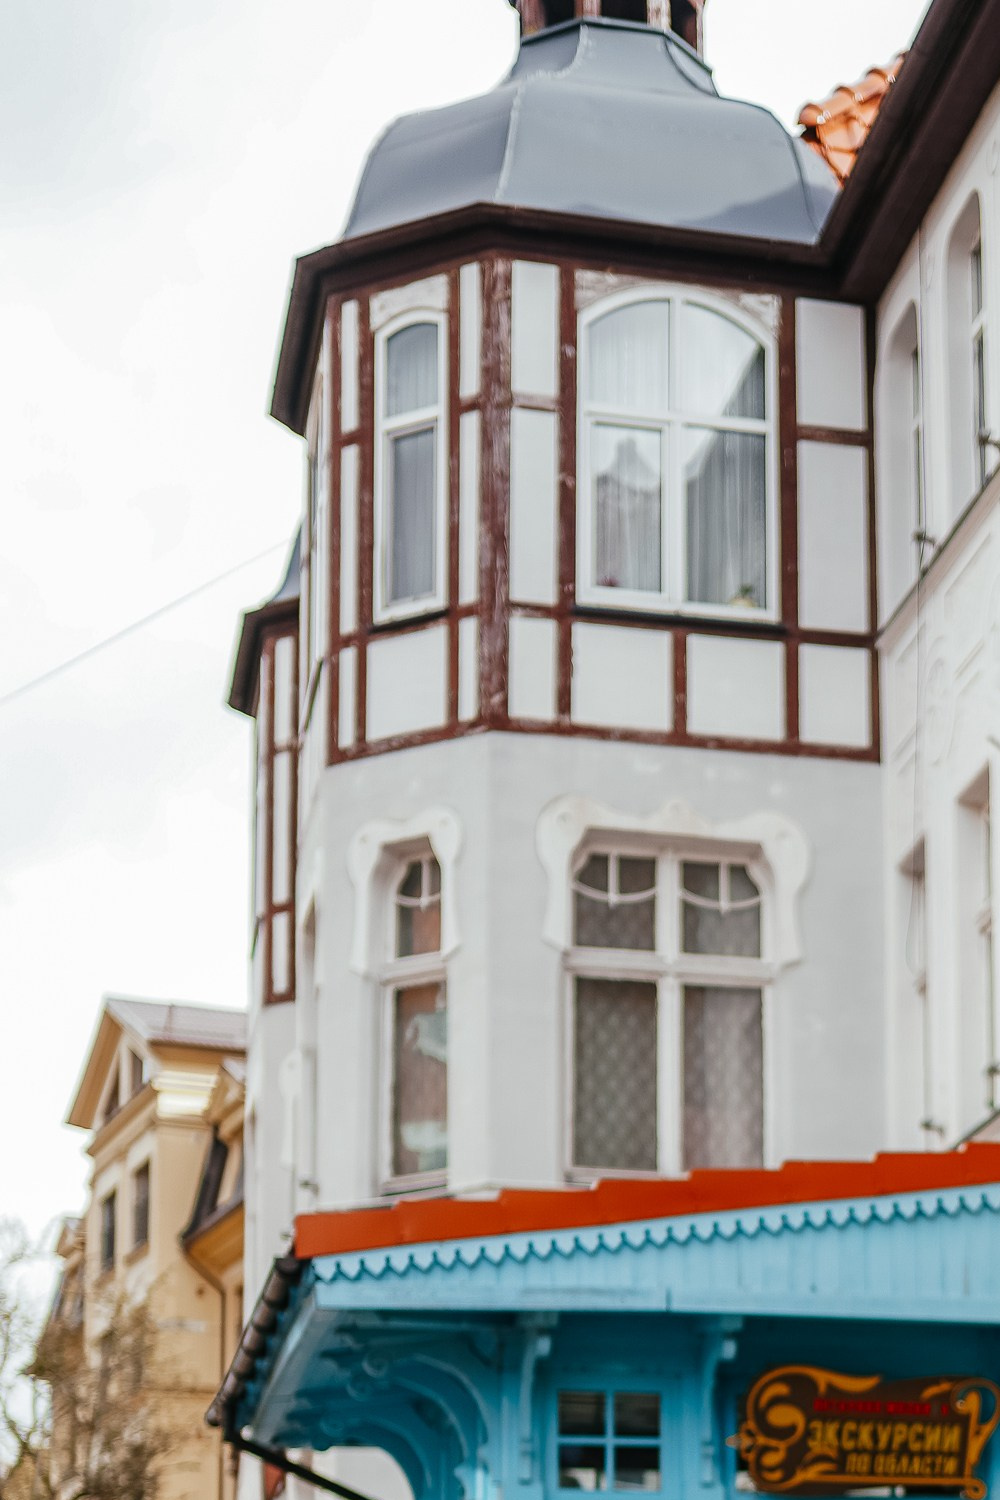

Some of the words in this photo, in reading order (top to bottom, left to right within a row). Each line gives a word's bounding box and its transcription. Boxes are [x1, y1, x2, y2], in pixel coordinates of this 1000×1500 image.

[807, 1419, 961, 1453] ЭКСКУРСИИ
[845, 1452, 871, 1473] ПО
[873, 1452, 959, 1475] ОБЛАСТИ
